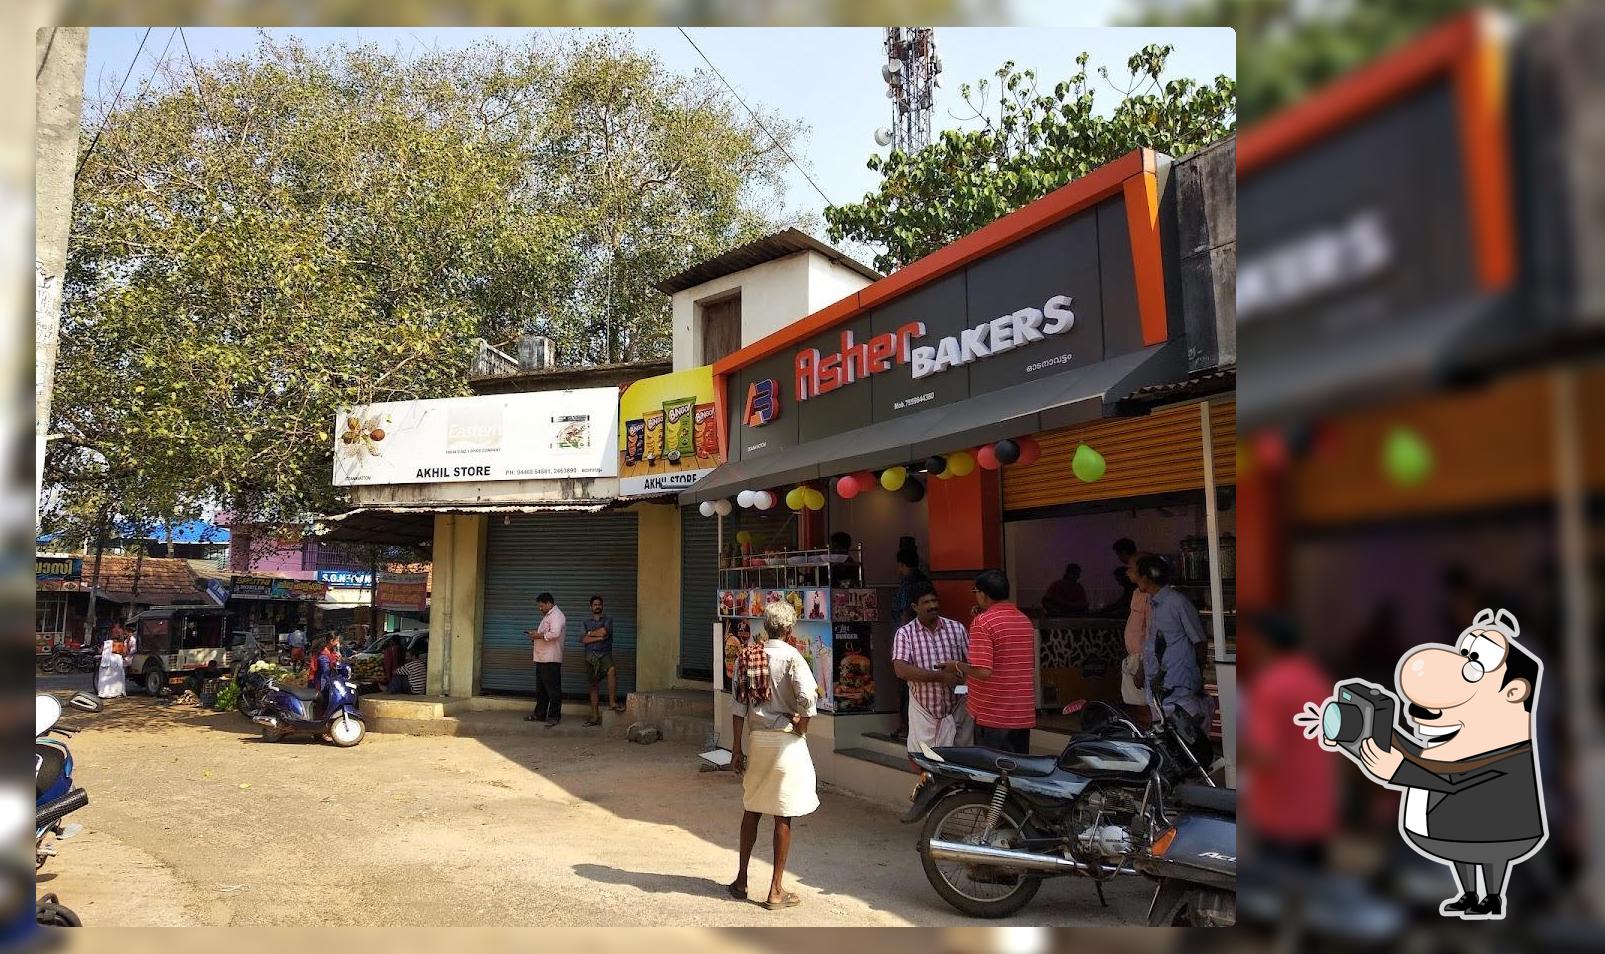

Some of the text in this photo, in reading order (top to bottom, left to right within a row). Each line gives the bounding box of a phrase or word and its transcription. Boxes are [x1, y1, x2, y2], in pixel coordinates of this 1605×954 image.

[795, 320, 926, 401] Asher
[911, 295, 1074, 379] BAKERS
[416, 466, 491, 478] AKHIL STORE
[644, 477, 667, 490] AKH
